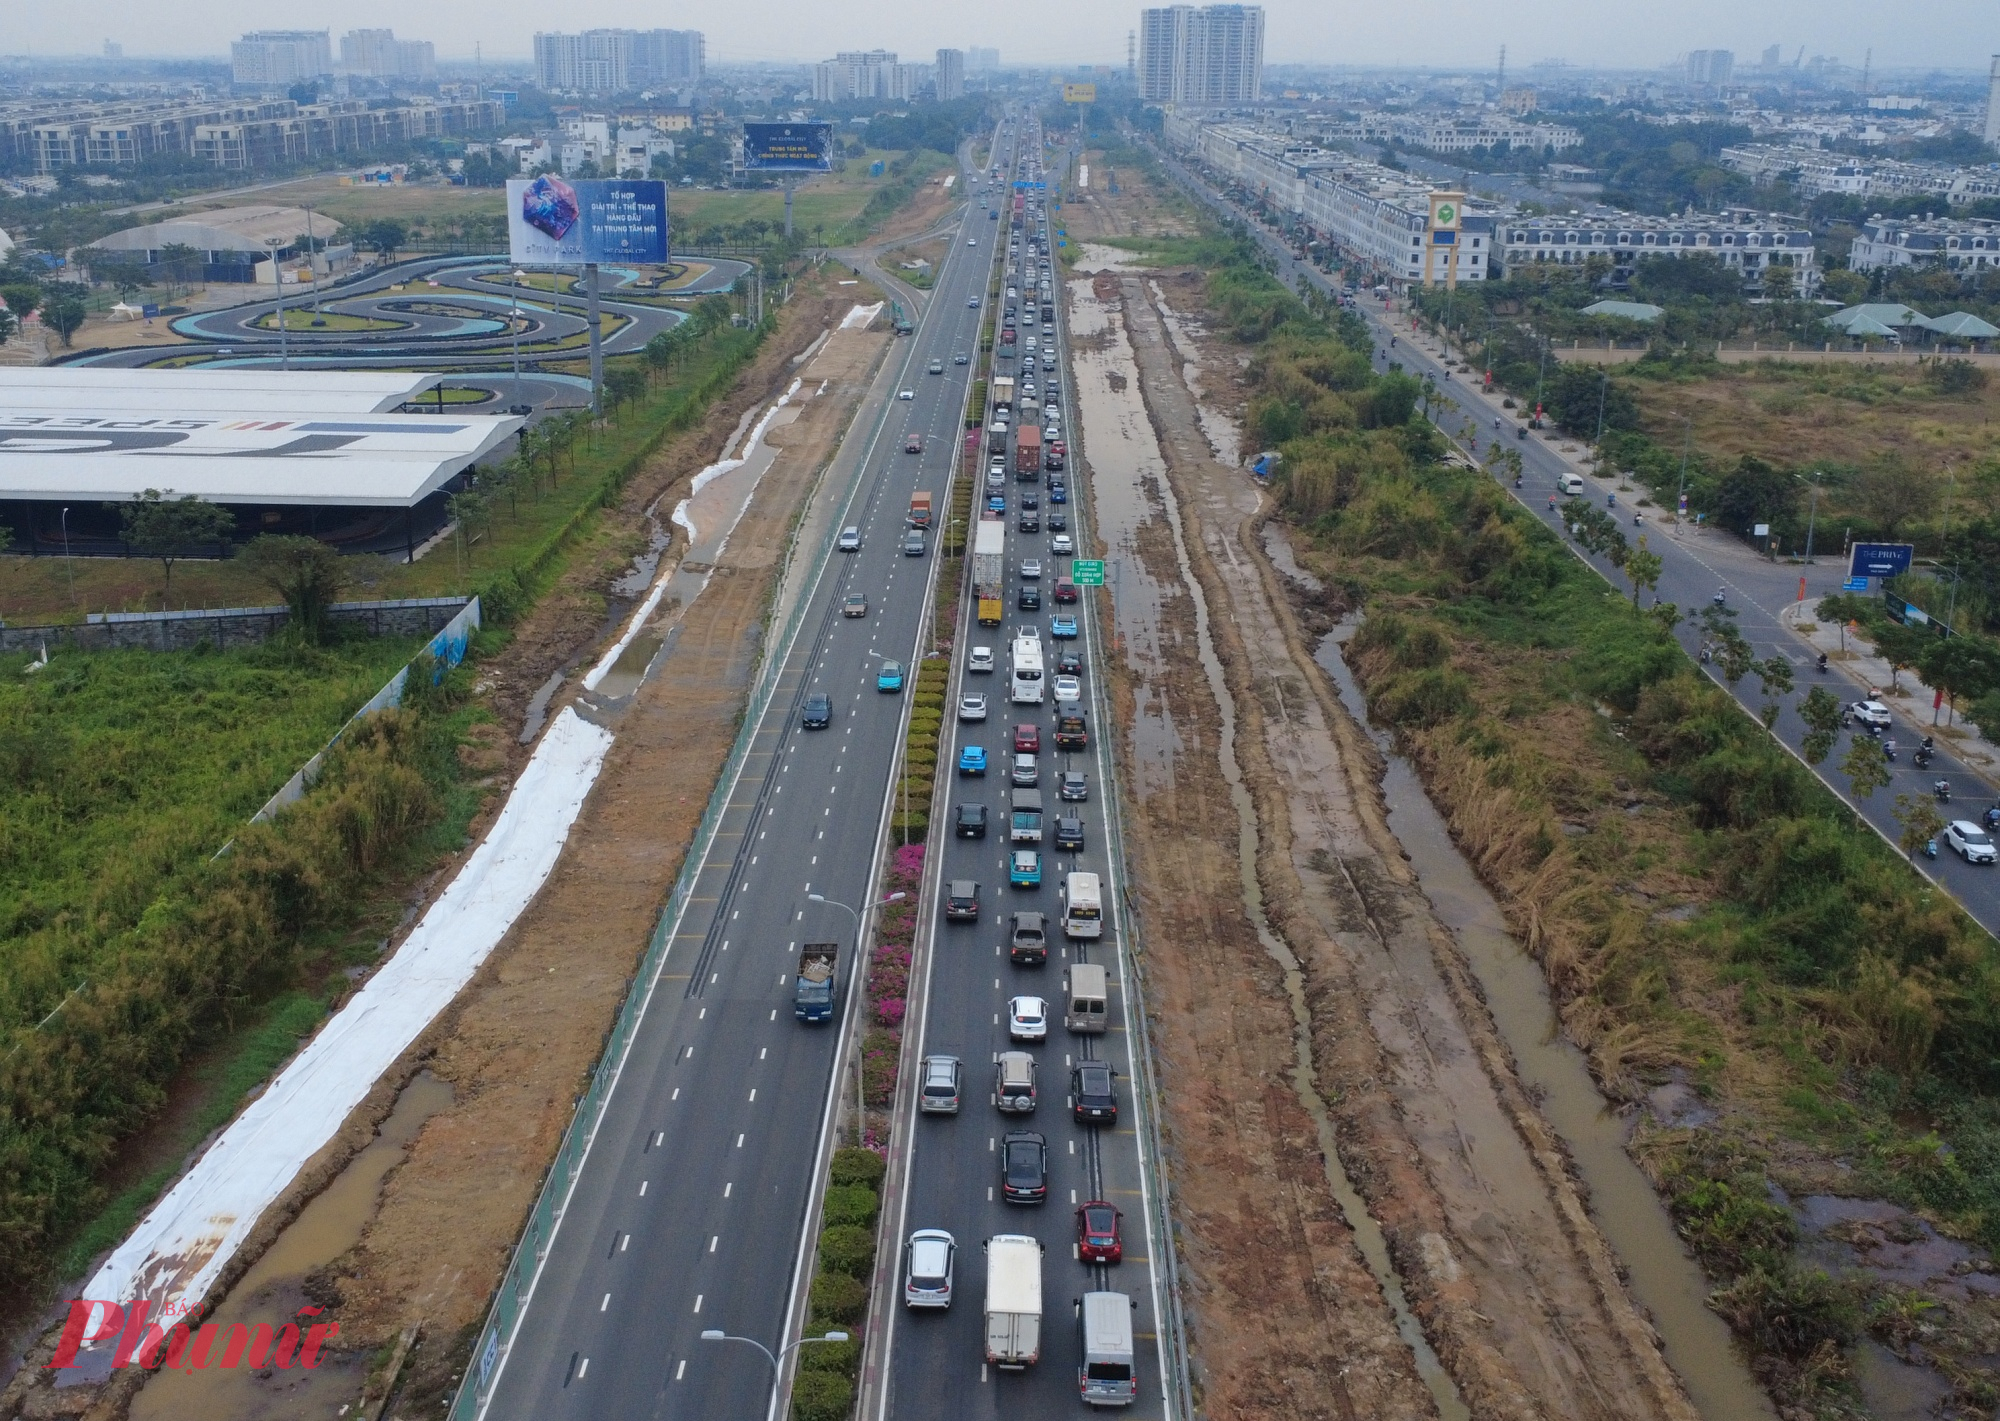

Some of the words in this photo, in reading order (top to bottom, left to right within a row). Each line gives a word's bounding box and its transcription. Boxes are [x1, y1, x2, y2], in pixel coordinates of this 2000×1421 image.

[611, 190, 620, 200] TỔ
[621, 192, 635, 201] HỢP
[606, 202, 617, 210] TRÍ
[623, 201, 637, 210] THỂ
[606, 213, 626, 222] HÀNG
[627, 213, 641, 222] ĐẦU
[592, 225, 603, 233] TẠI
[604, 225, 627, 233] TRUNG
[628, 224, 643, 233] TÂM
[644, 224, 657, 233] MỚI
